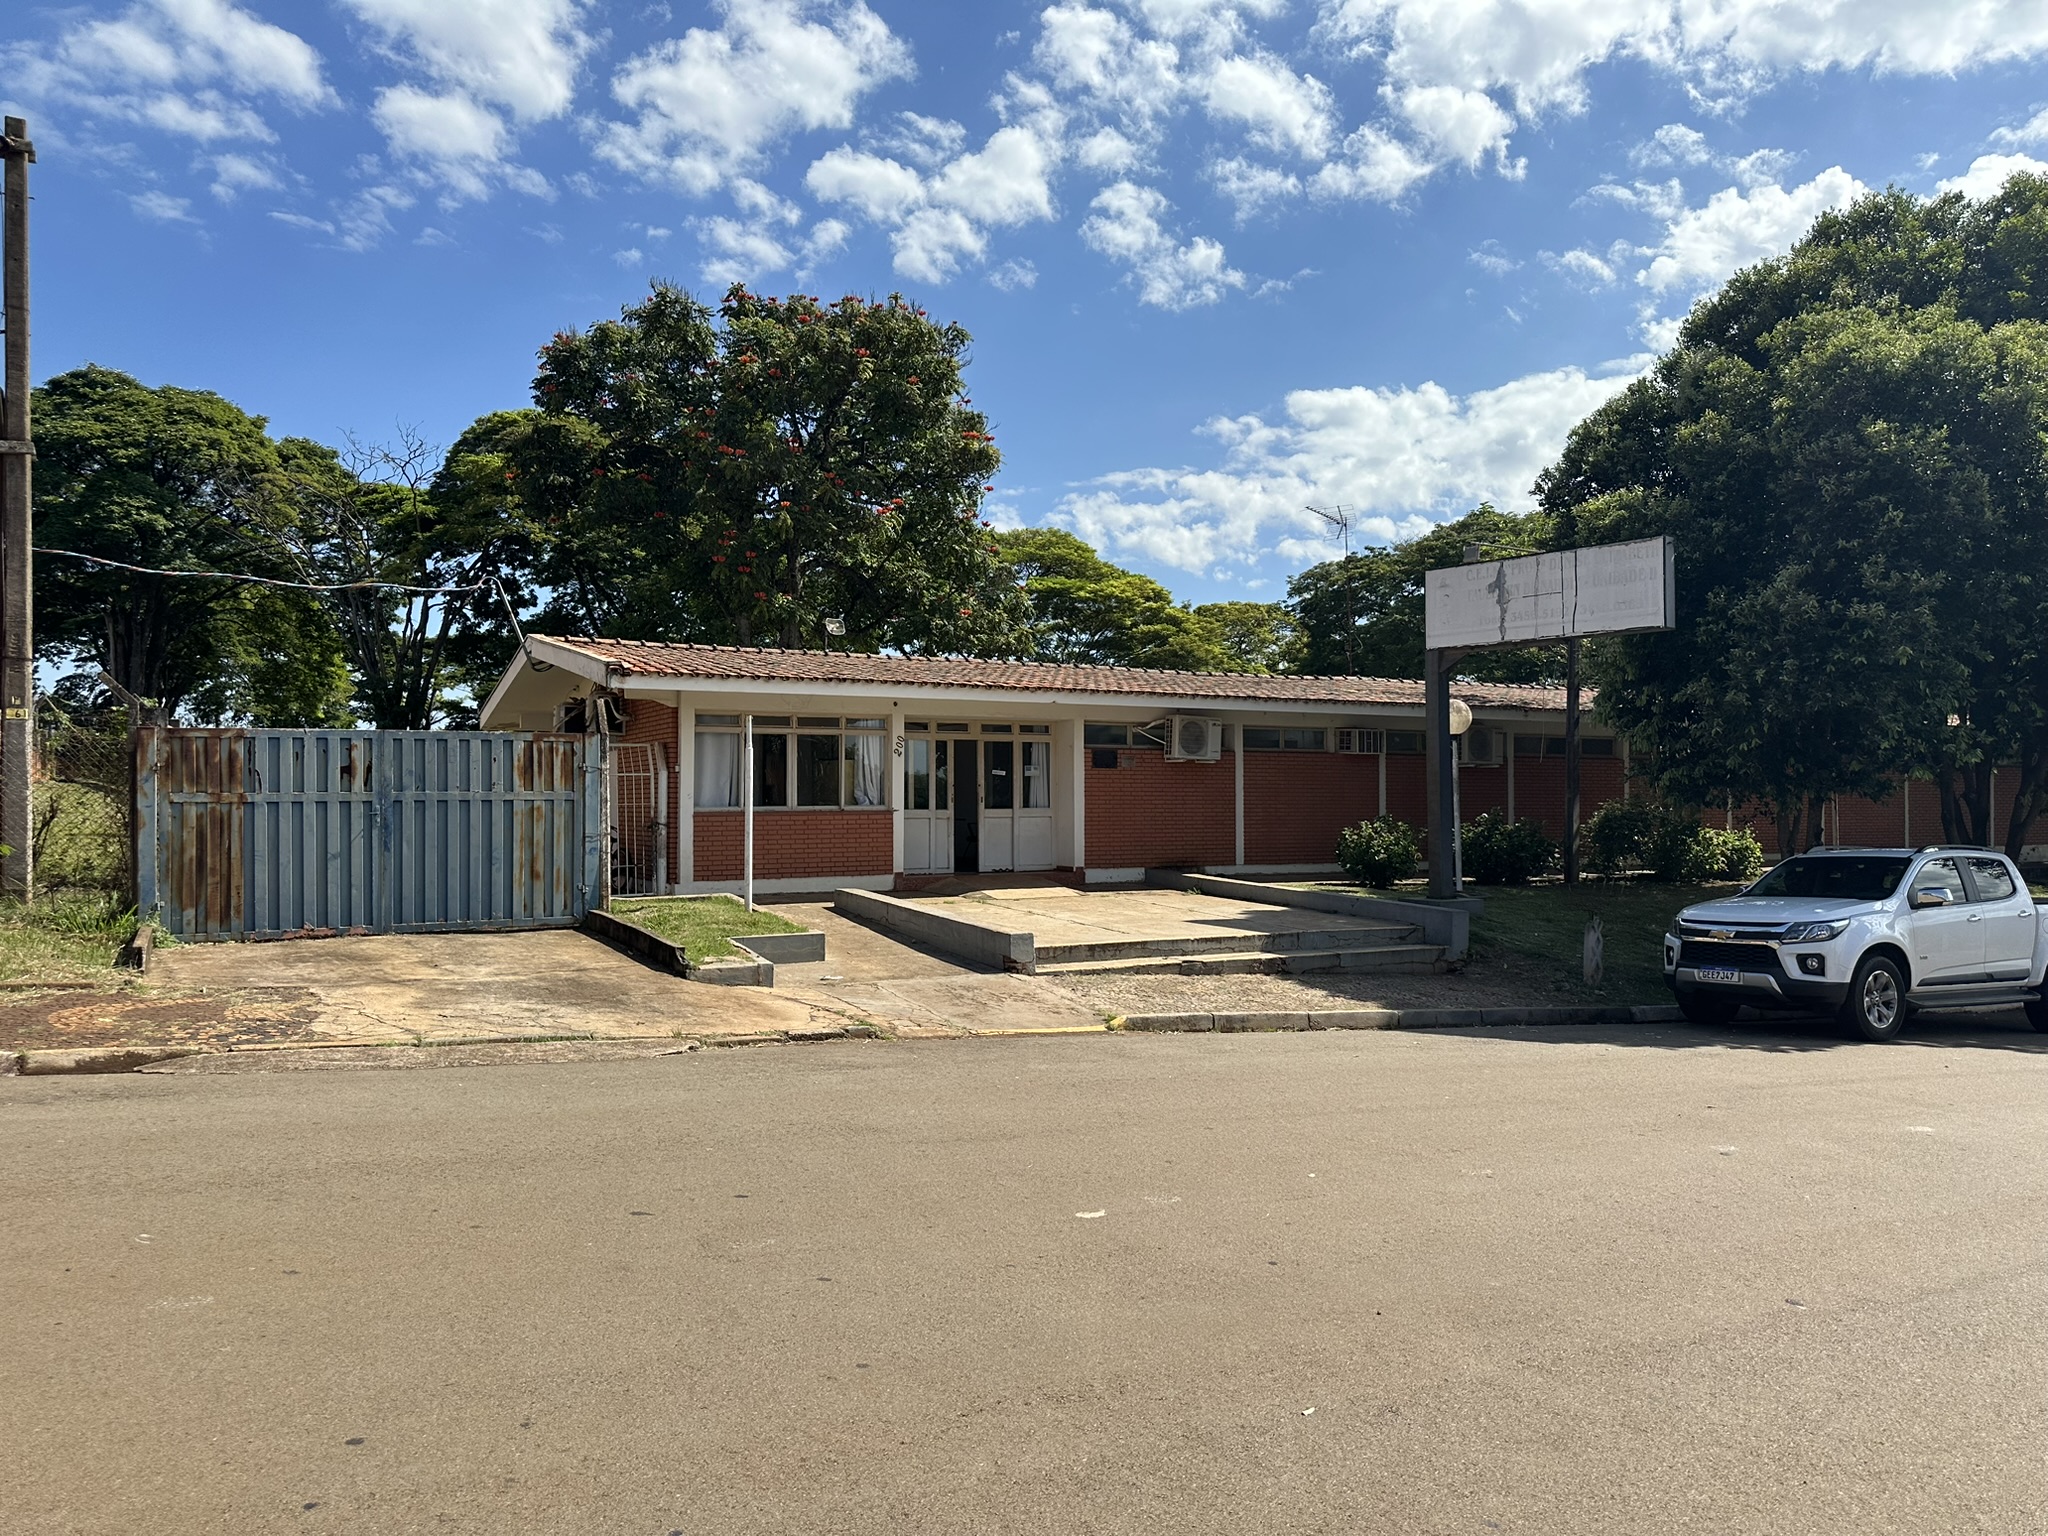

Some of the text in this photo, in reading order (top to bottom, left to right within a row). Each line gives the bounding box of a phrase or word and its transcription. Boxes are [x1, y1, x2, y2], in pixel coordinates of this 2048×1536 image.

[1593, 567, 1646, 587] UNIDADE
[893, 735, 905, 757] 200
[1702, 970, 1734, 980] GEE7J47
